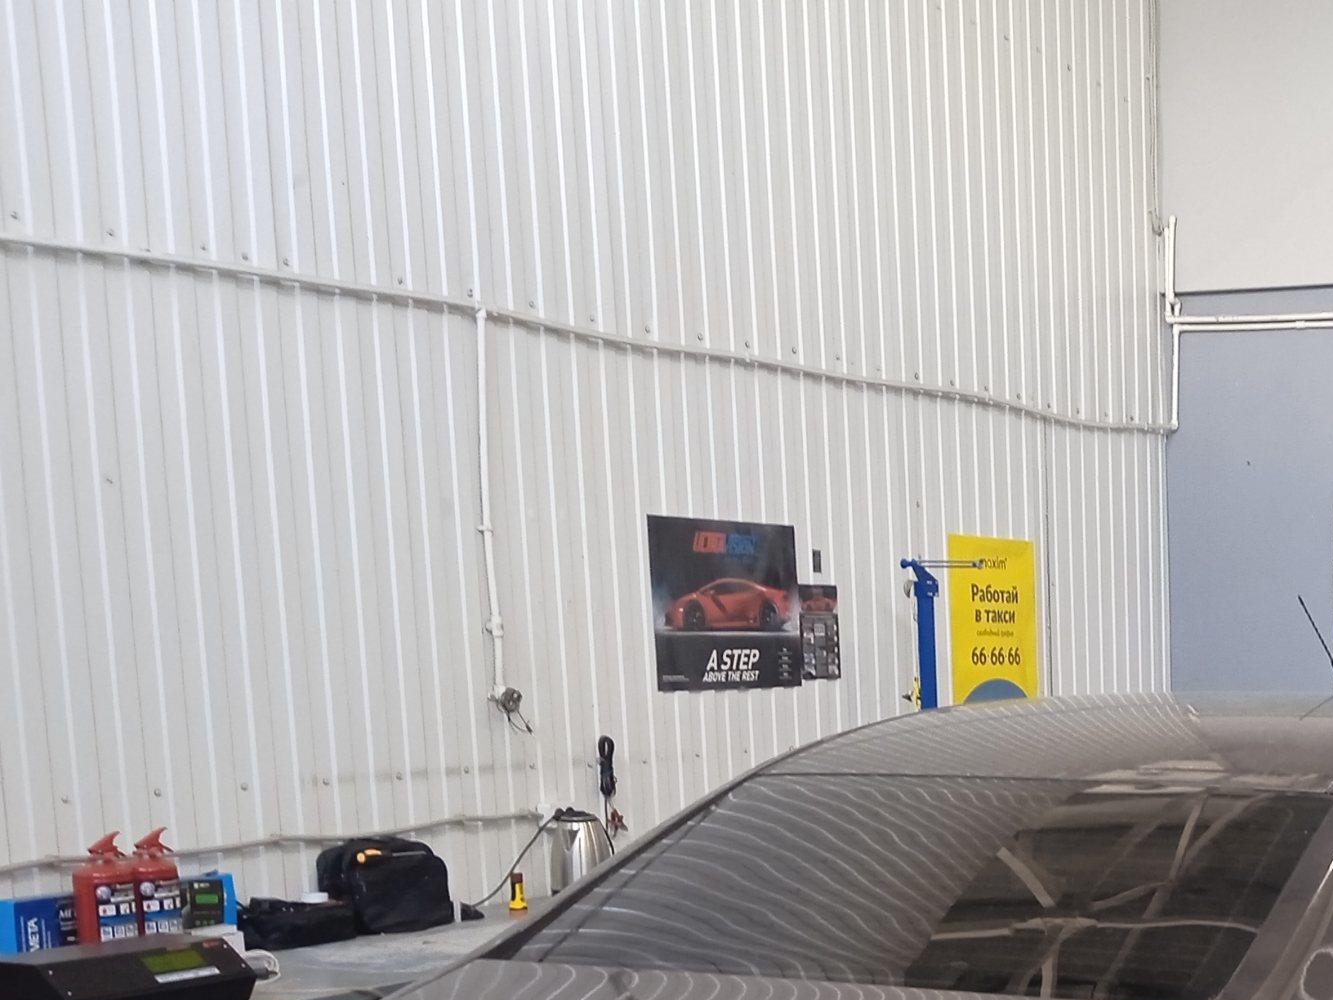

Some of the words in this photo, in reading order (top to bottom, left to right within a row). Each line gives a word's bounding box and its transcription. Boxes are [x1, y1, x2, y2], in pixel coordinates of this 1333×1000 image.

[971, 583, 1018, 604] Работай
[975, 610, 982, 622] в
[984, 609, 1015, 624] такси
[706, 650, 718, 671] A
[721, 649, 760, 671] STEP
[703, 671, 726, 682] ABOVE
[728, 671, 741, 682] THE
[742, 670, 760, 681] REST
